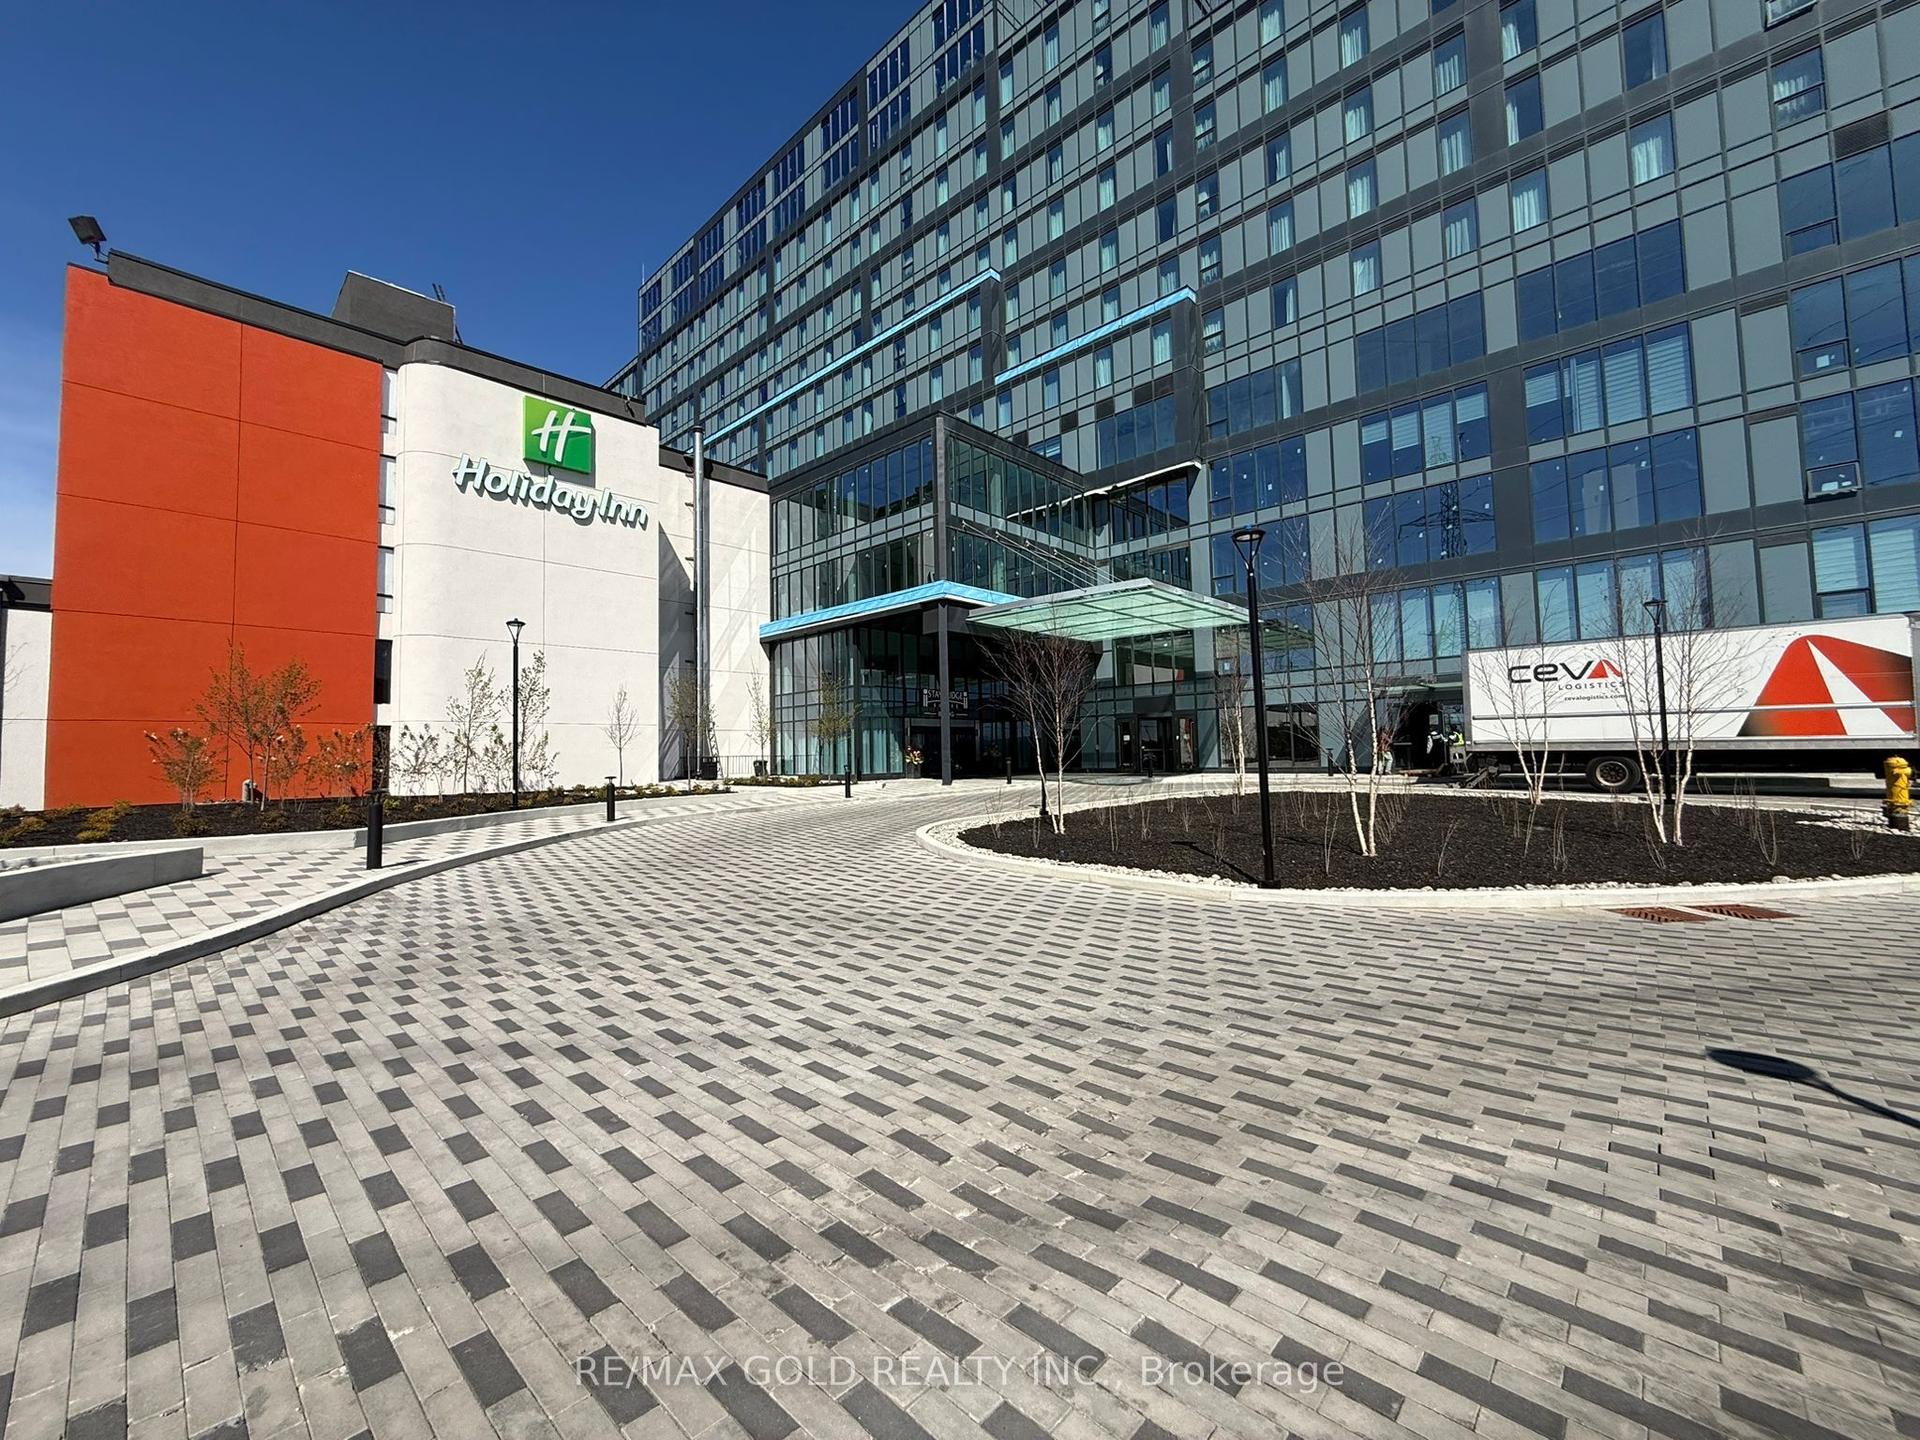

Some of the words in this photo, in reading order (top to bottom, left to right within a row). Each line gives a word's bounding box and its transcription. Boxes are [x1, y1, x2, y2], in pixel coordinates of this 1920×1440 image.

[452, 452, 597, 520] Holiday
[597, 487, 649, 526] Inn
[1558, 681, 1625, 691] LOGISTICS
